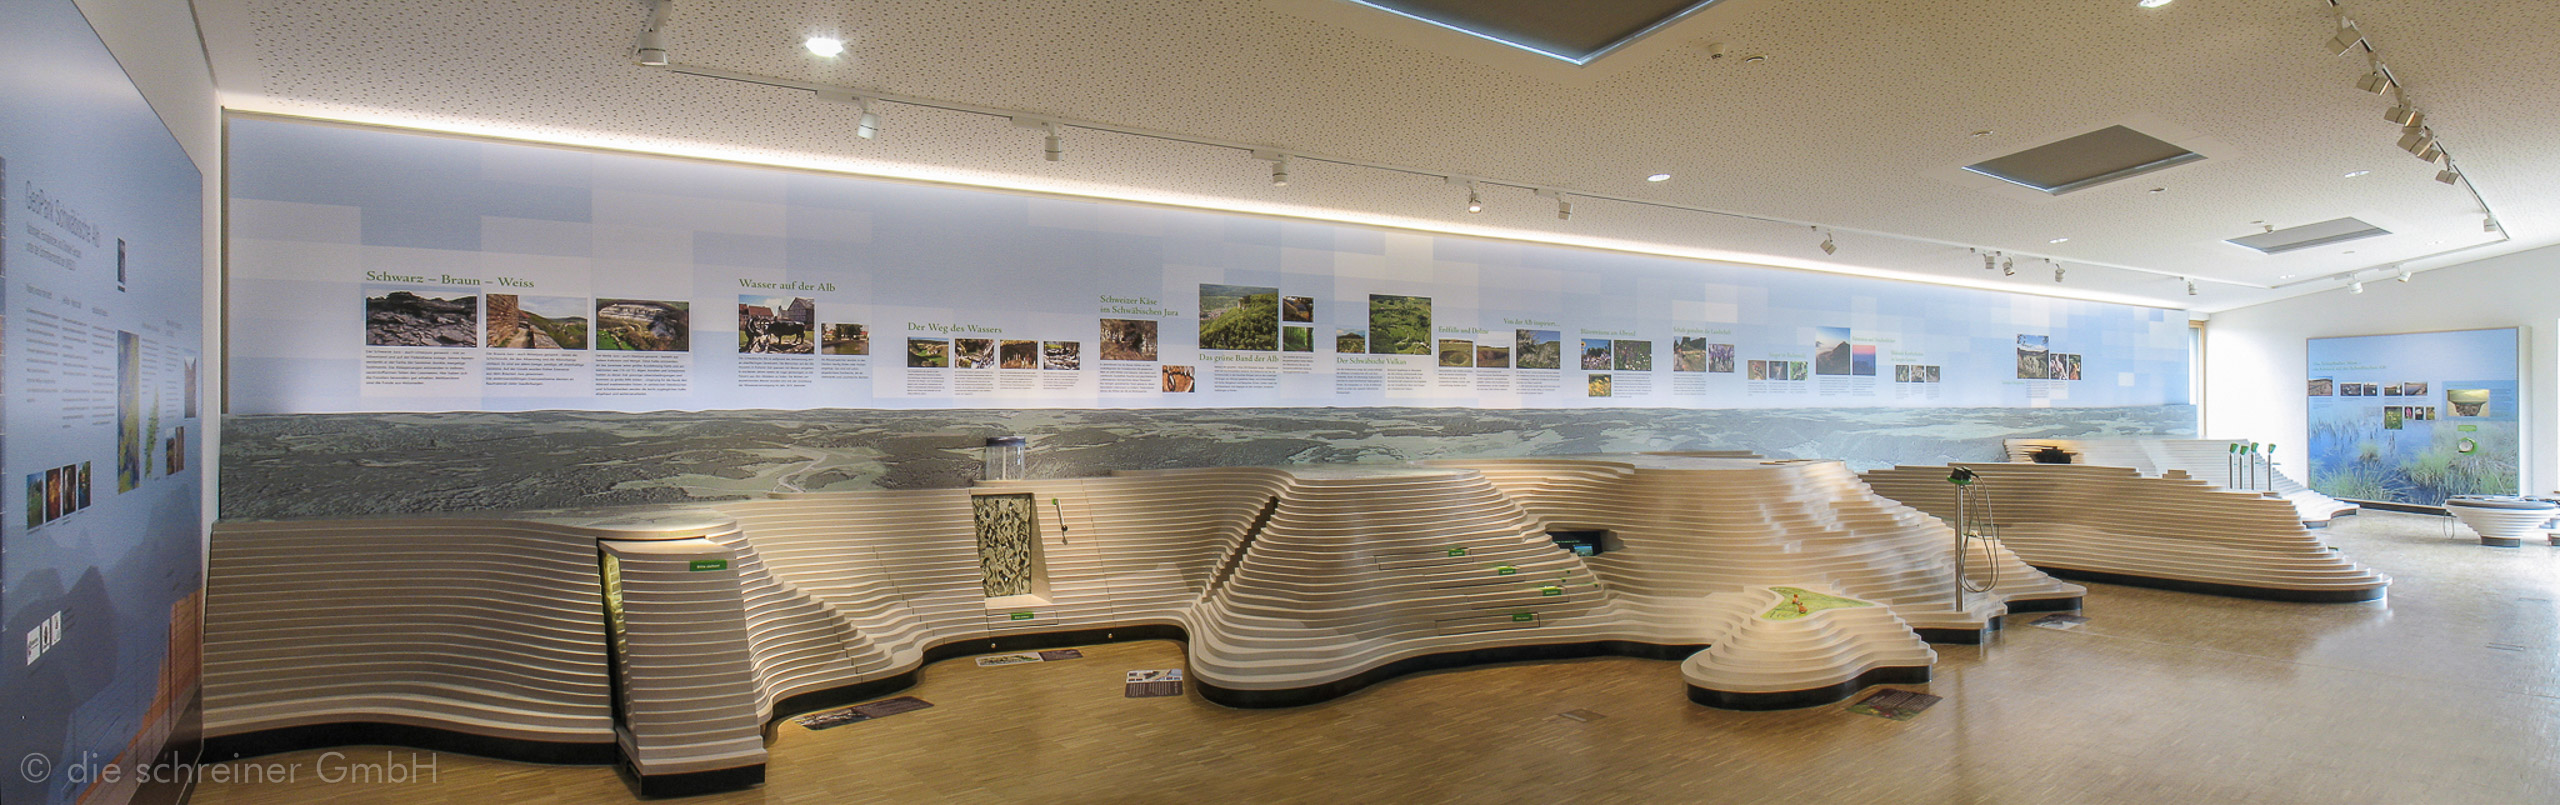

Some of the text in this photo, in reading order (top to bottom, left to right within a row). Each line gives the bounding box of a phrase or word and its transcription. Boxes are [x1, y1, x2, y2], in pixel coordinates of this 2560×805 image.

[365, 270, 424, 283] Schwarz
[441, 274, 481, 286] Braun
[498, 277, 535, 288] Weiss
[738, 278, 836, 292] Wasser auf der Alb
[1099, 295, 1158, 305] Schweizer Käse
[1112, 305, 1162, 316] Schwäbischen
[1162, 308, 1179, 318] Jura
[908, 322, 1002, 334] Der Weg des Wassers
[1199, 353, 1213, 361] Das
[1214, 354, 1234, 363] grüne
[1235, 354, 1253, 362] Band
